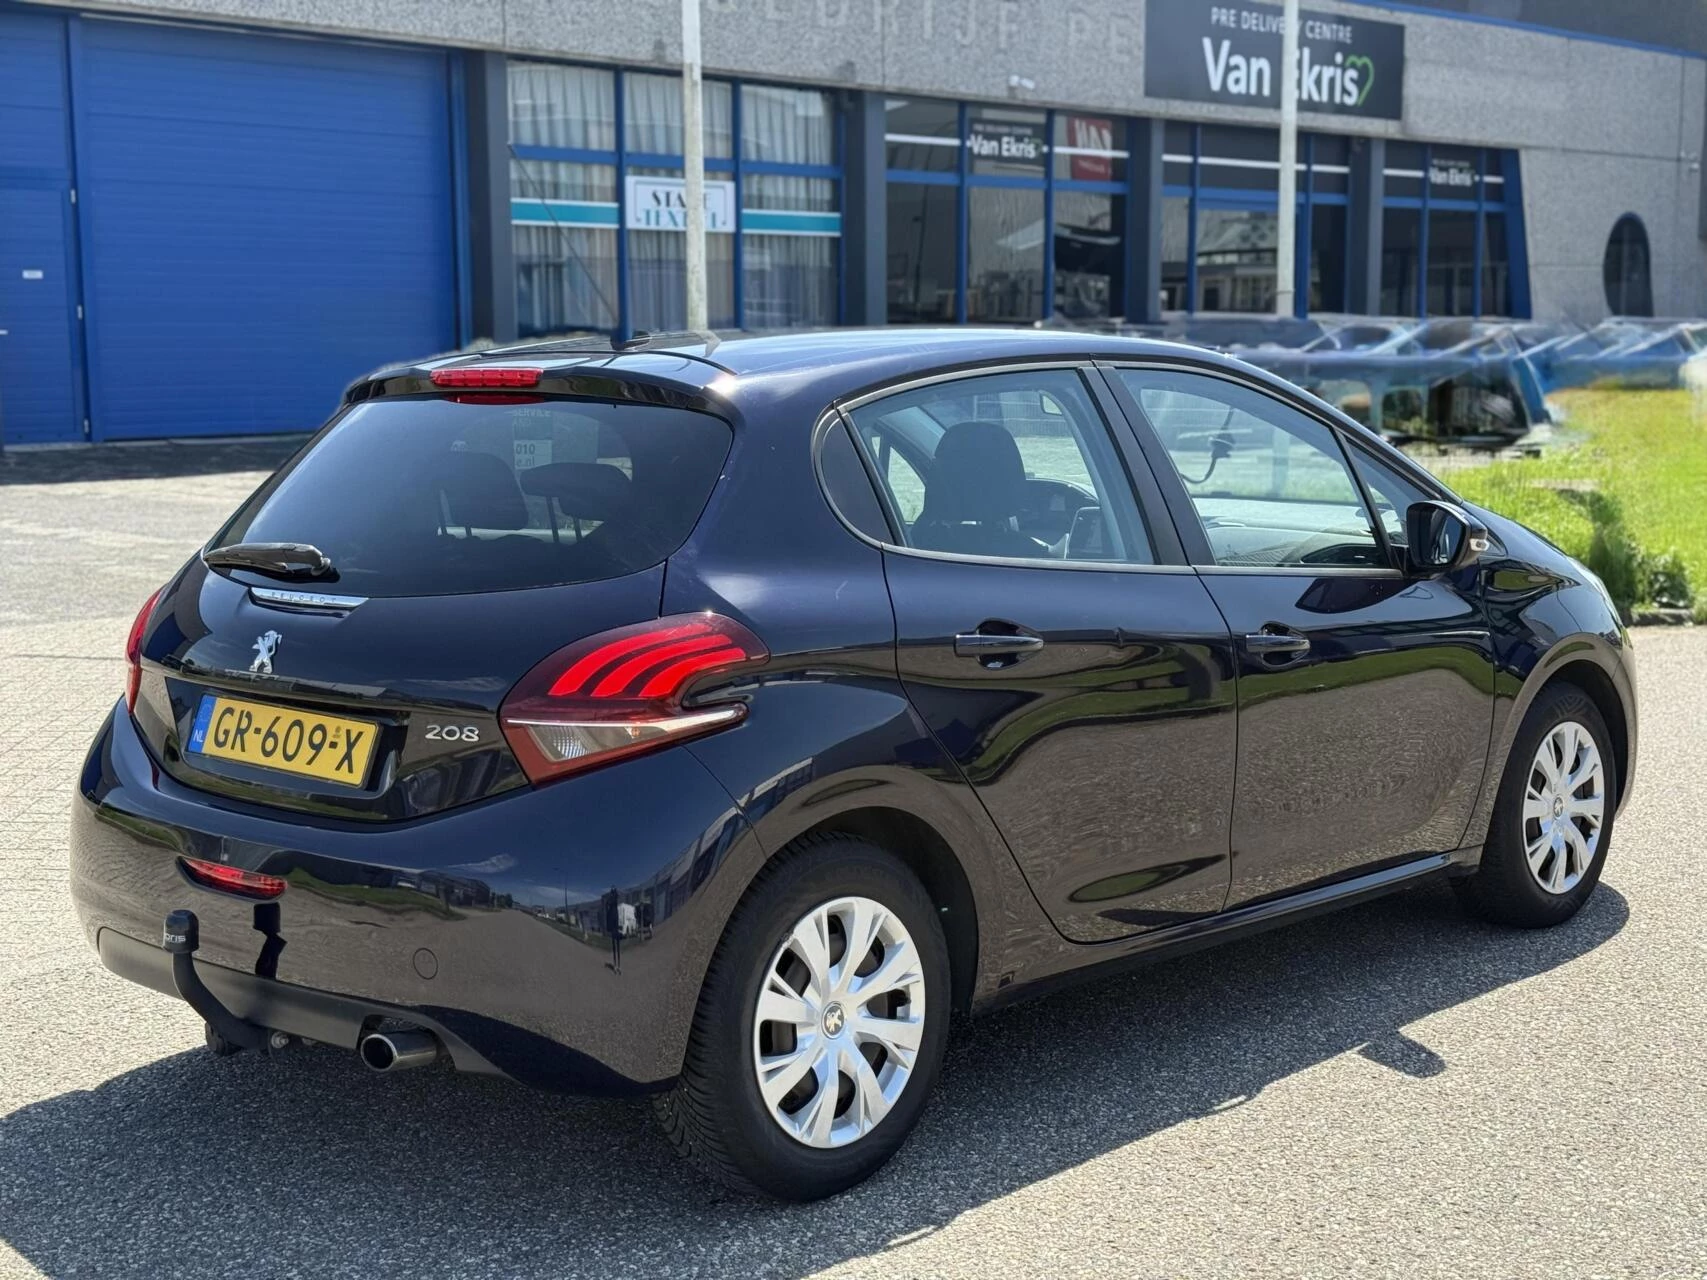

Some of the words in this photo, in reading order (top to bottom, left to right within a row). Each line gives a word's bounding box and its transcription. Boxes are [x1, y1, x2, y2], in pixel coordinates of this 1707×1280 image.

[1211, 7, 1237, 28] PRE
[1241, 11, 1303, 35] DELIVE
[1305, 20, 1353, 44] CENTRE
[1202, 37, 1272, 97] Van
[1295, 47, 1360, 106] kris
[969, 133, 999, 156] Van
[1001, 135, 1036, 159] Ekris
[651, 189, 711, 210] STAE
[643, 208, 719, 230] TEXTL
[272, 592, 337, 603] PEUGEOT
[193, 729, 203, 743] NL
[213, 706, 364, 774] GR-609-X
[425, 724, 479, 741] 208
